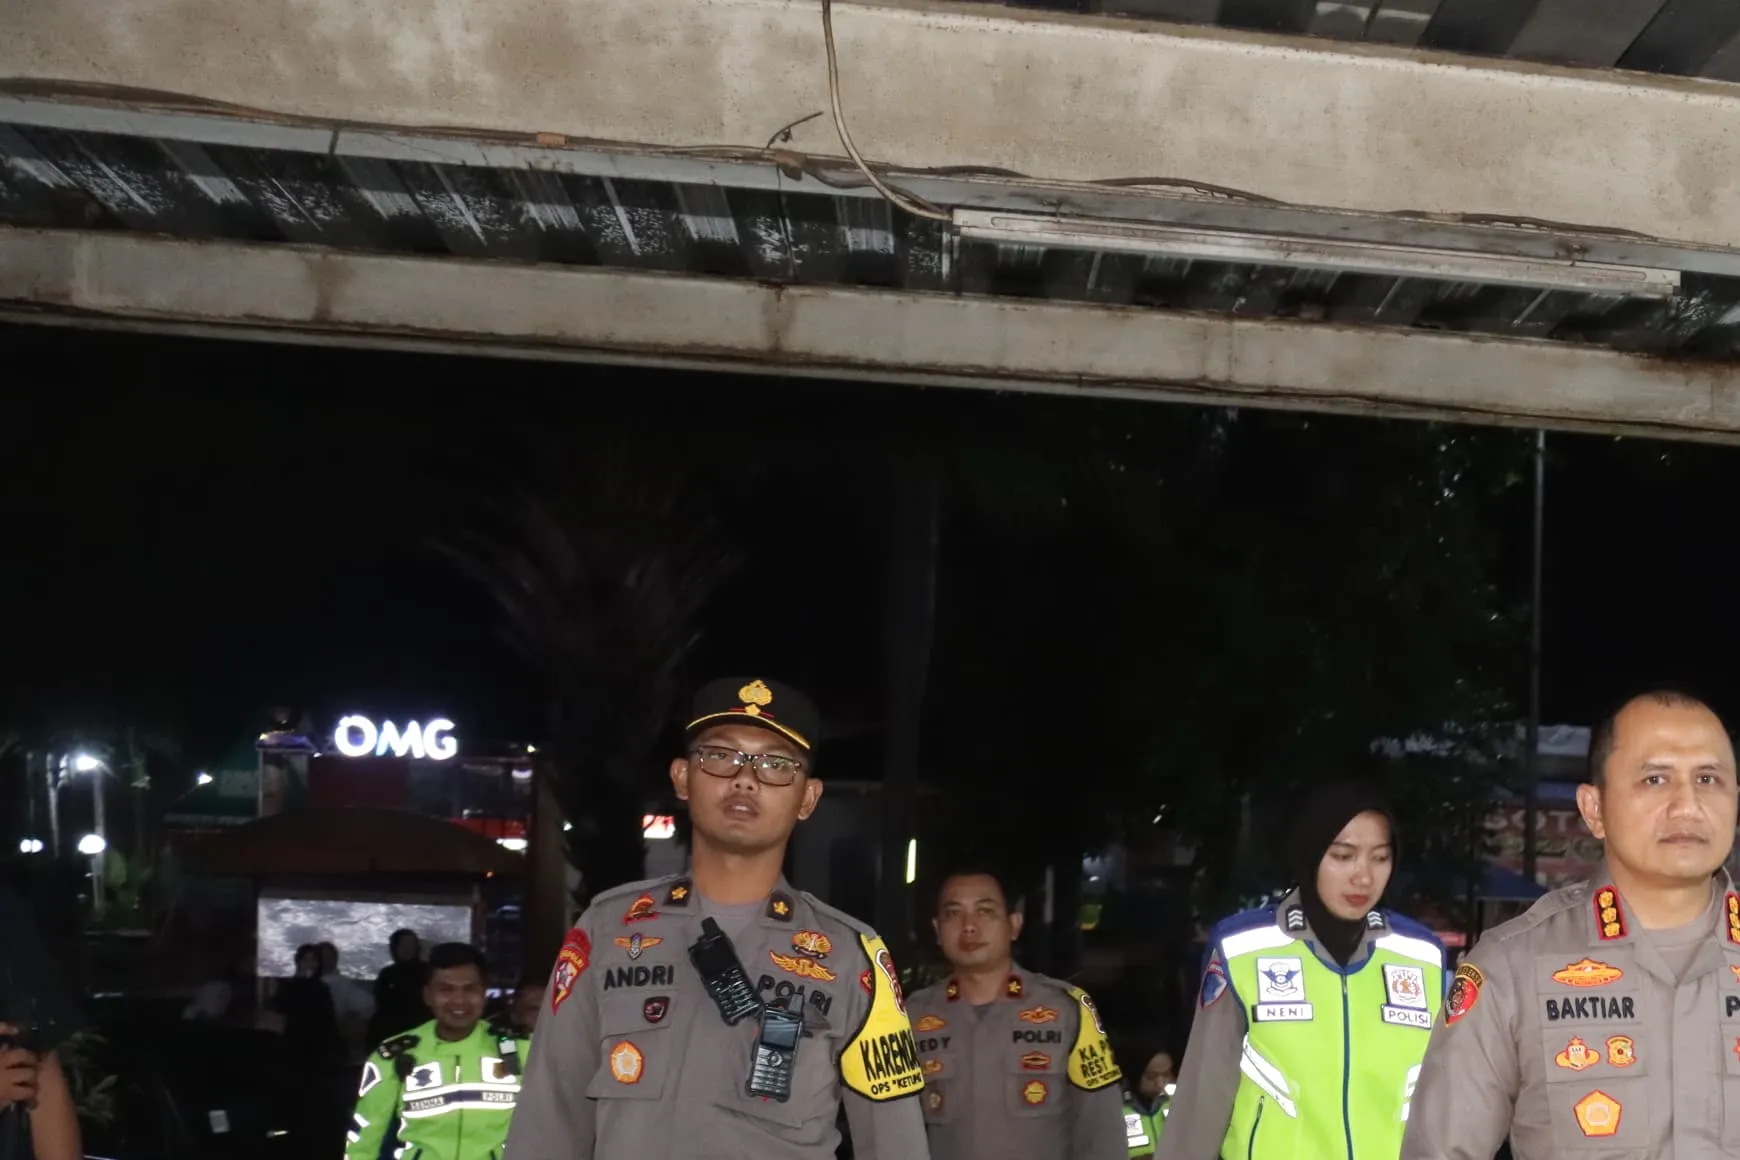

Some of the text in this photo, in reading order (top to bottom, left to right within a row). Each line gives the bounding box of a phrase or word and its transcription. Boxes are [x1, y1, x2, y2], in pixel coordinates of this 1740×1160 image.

[334, 714, 458, 760] OMG
[1483, 808, 1592, 833] SOT
[604, 965, 674, 991] ANDRI
[1267, 1007, 1304, 1017] NENI
[1546, 997, 1635, 1021] BAKTIAR
[1012, 1030, 1061, 1044] POLRI
[871, 1082, 892, 1095] OPS
